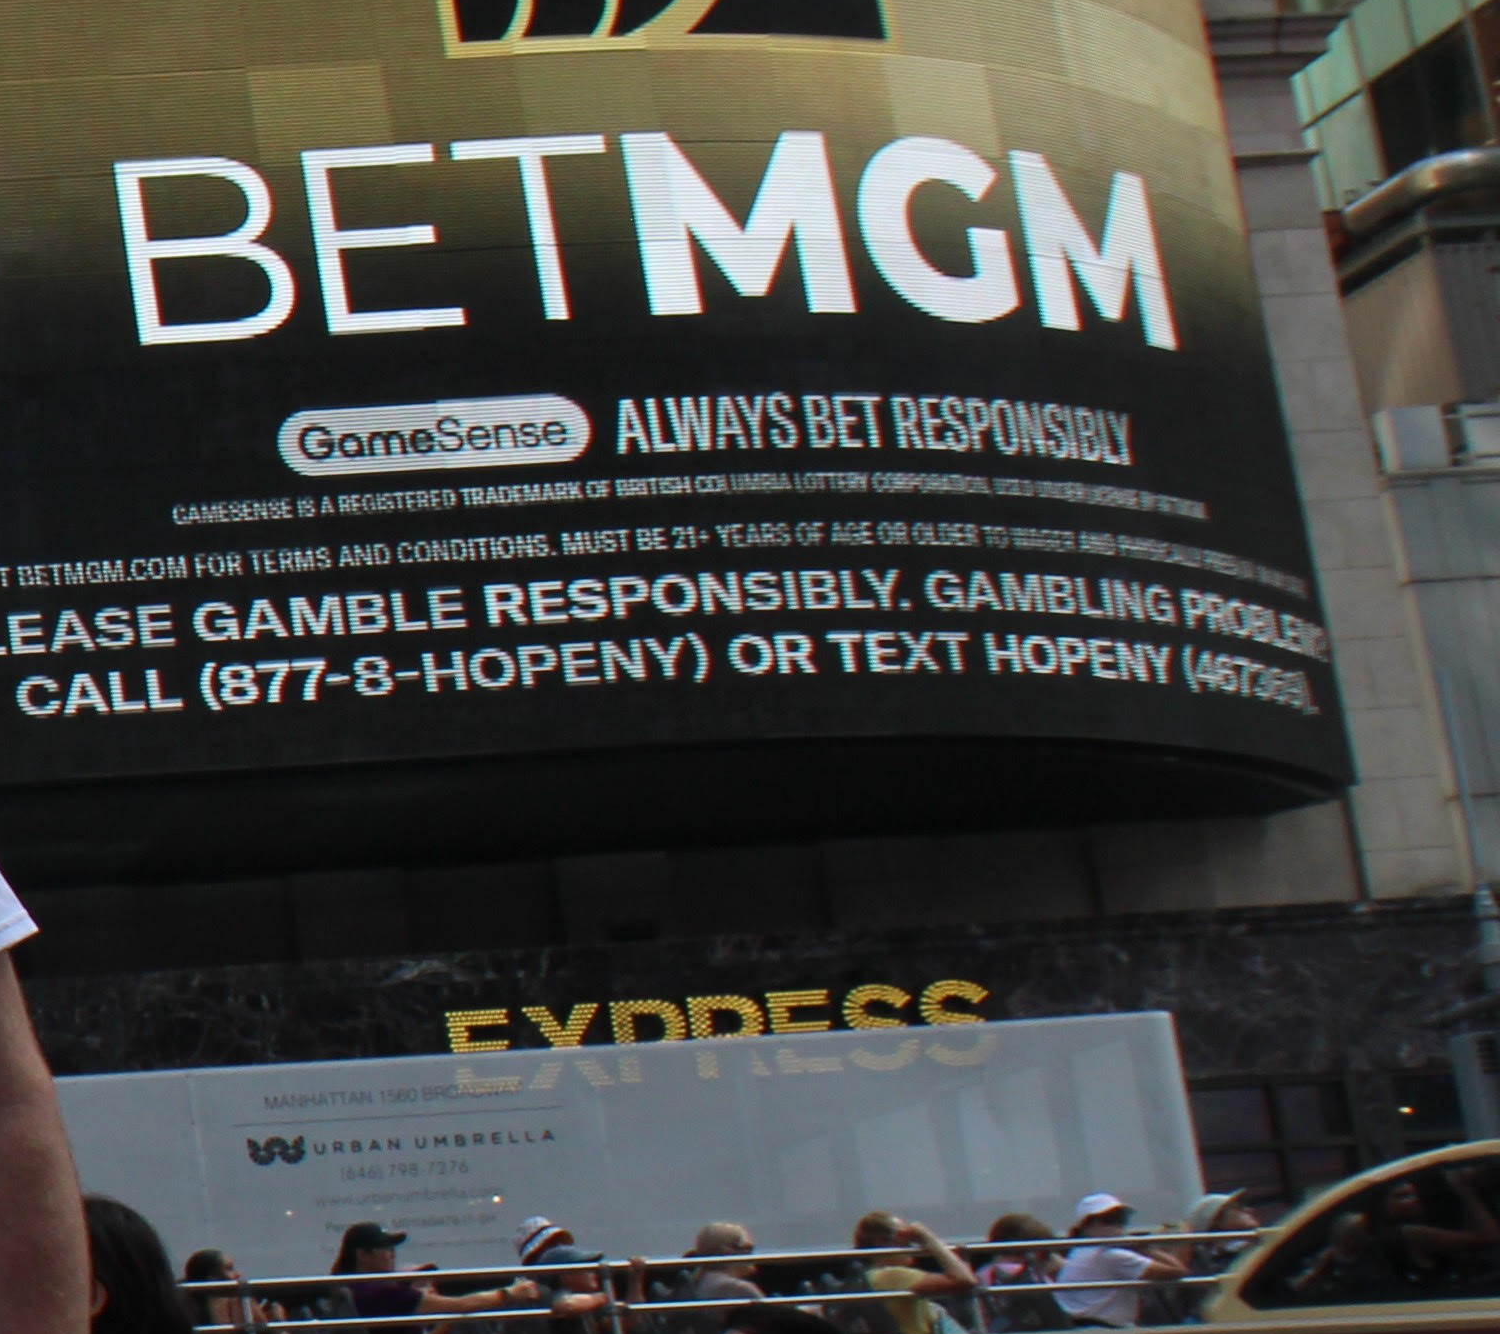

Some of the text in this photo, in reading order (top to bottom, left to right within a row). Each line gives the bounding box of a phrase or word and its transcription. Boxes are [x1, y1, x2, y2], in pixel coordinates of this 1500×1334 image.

[112, 130, 1179, 352] BETMGM
[300, 394, 1135, 465] GameSense ALWAYS BET RESPONSIBLY
[173, 496, 294, 525] GAMESENSE
[338, 488, 457, 514] REGISTERED
[460, 481, 584, 507] TRADEMARK
[586, 479, 612, 499] OF
[16, 556, 187, 587] BETMGM.COM
[193, 552, 243, 578] FOR
[247, 546, 332, 575] TERMS
[338, 543, 393, 568] AND
[397, 534, 558, 564] CONDITIONS.
[560, 529, 632, 555] MUST
[635, 527, 667, 551] BE
[671, 525, 712, 550] 21+
[714, 523, 792, 548] YEARS
[795, 521, 826, 546] OF
[830, 521, 876, 546] AGE
[192, 588, 468, 642] GAMBLE
[483, 569, 912, 627] RESPONSIBLY.
[924, 569, 1178, 626] GAMBLING
[16, 669, 184, 717] CALL
[200, 631, 711, 712] (877-8-HOPENY)
[728, 631, 817, 677] OR
[826, 631, 970, 673] TEXT
[985, 632, 1173, 685] HOPENY
[264, 1090, 372, 1110] MANHATTAN
[313, 1129, 556, 1156] URBAN UMBRELLA
